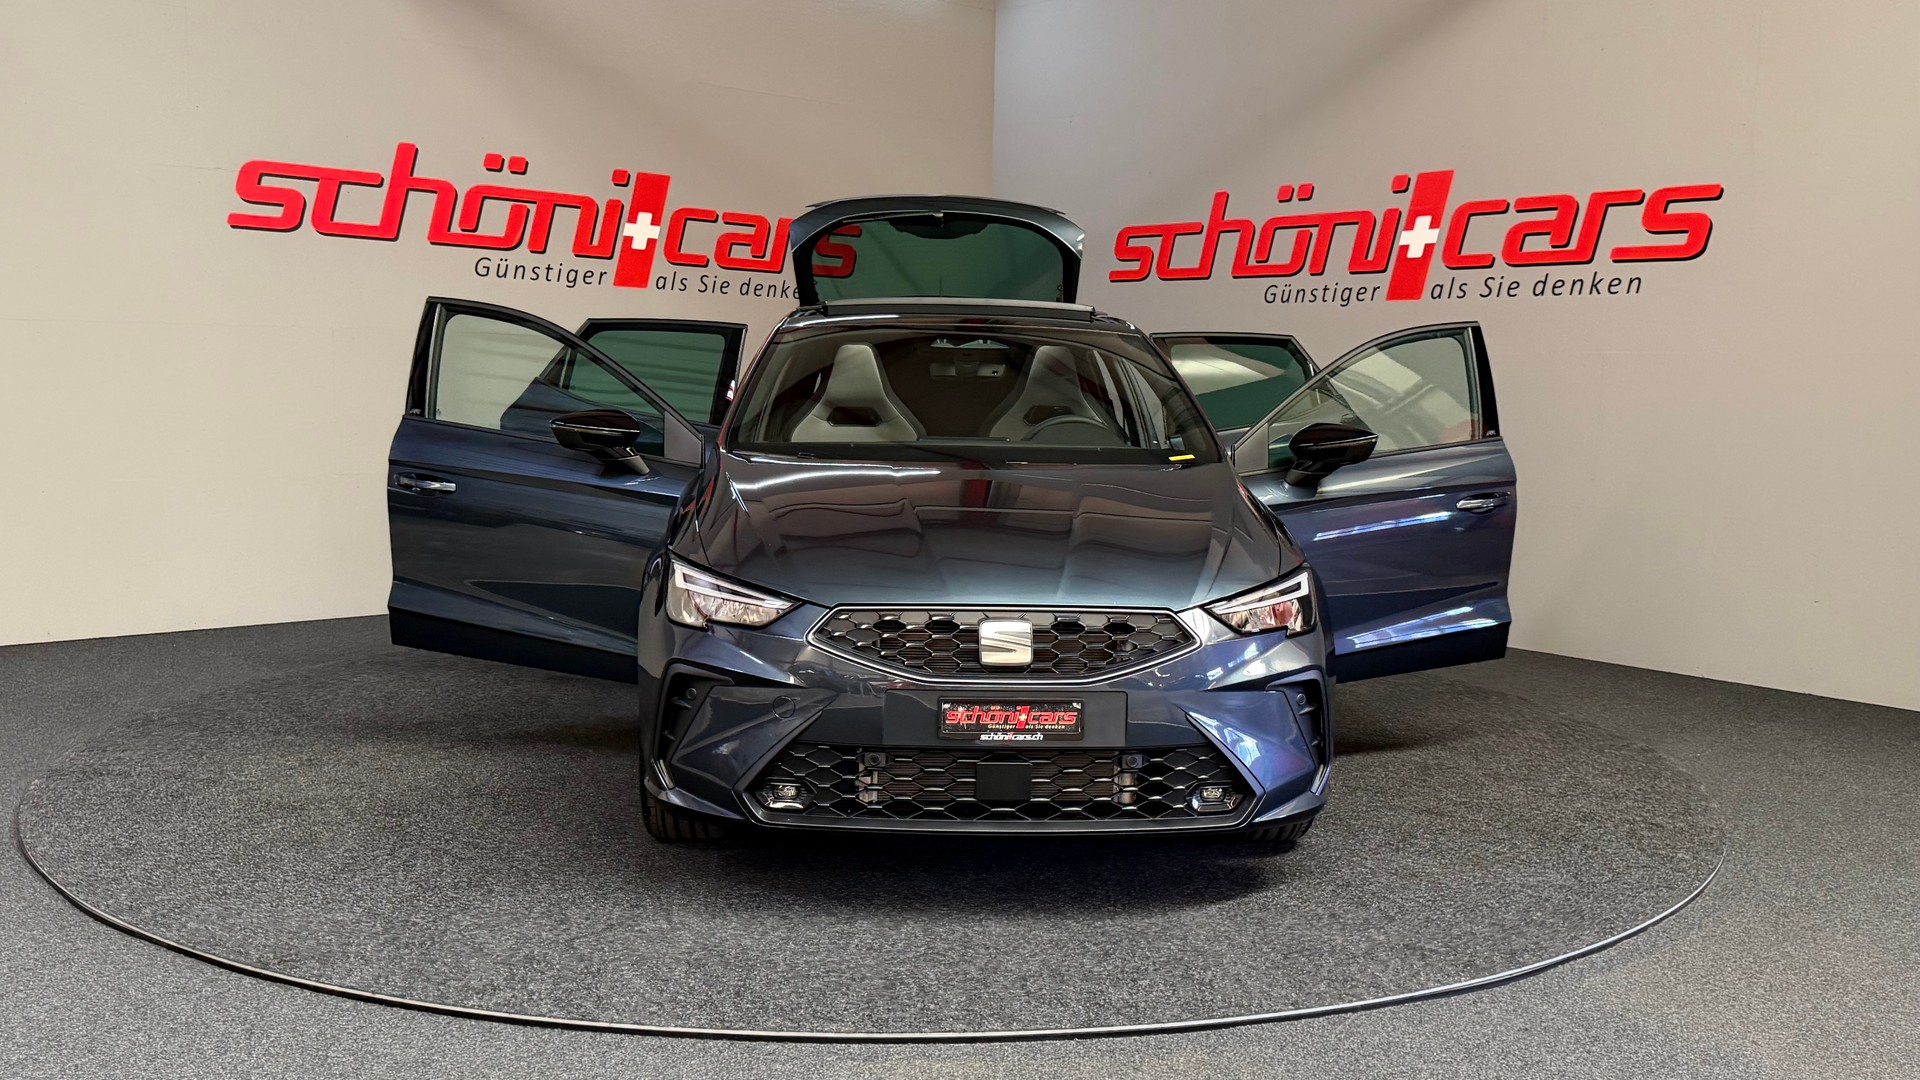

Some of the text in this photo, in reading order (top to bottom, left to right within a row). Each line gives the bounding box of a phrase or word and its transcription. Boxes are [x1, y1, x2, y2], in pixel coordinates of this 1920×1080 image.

[474, 256, 801, 300] Günstiger als Sie denke
[1263, 271, 1643, 307] Günstiger als Sie denken
